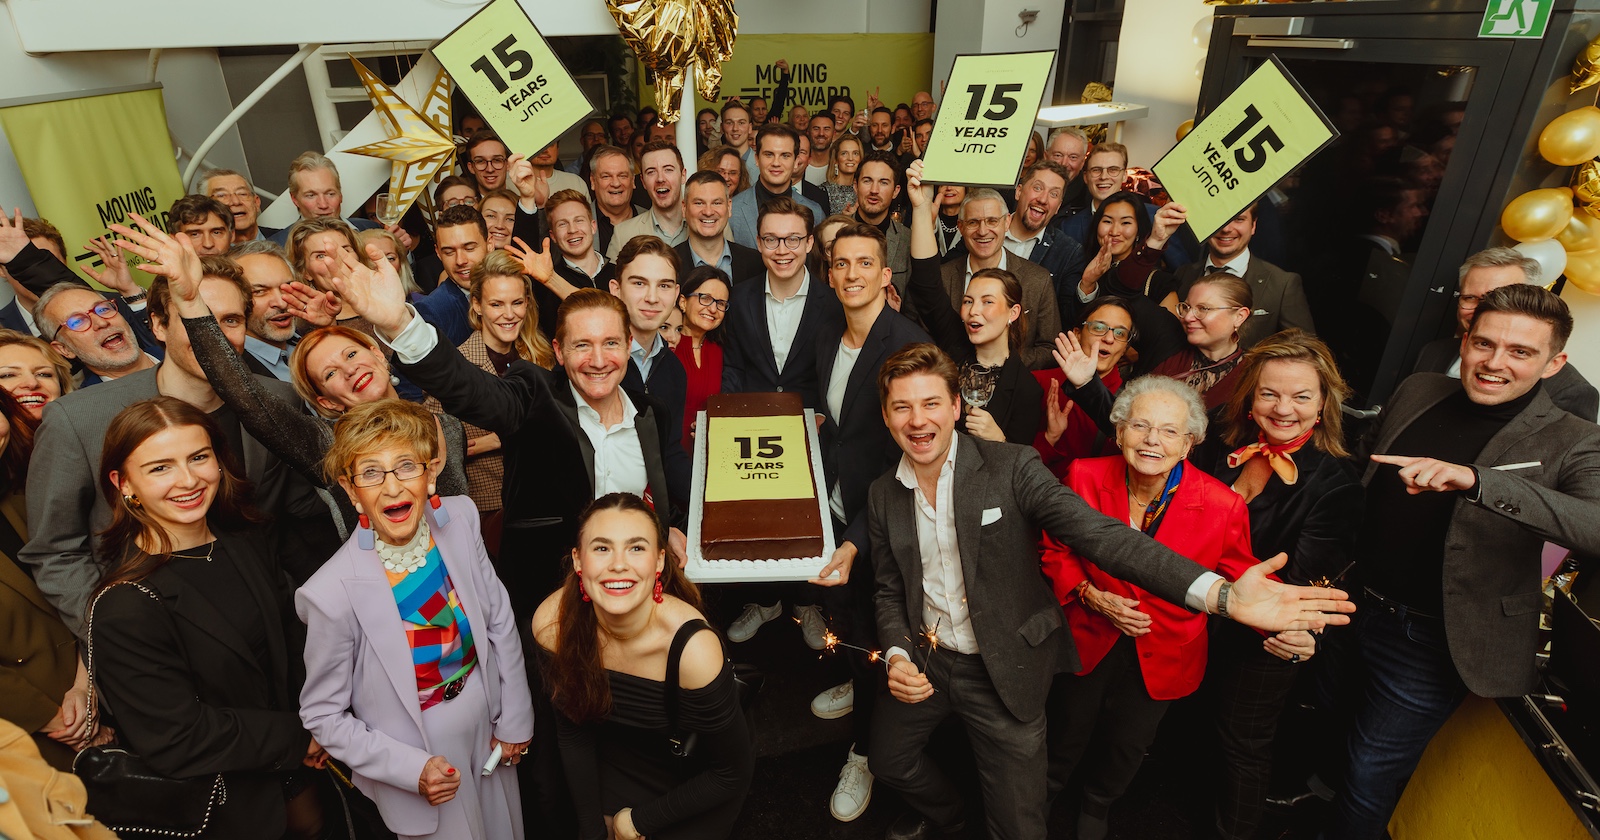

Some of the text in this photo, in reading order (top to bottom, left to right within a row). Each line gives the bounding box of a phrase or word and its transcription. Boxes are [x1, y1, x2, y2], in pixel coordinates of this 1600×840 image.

[470, 33, 534, 95] 15
[500, 74, 548, 112] YEARS
[964, 83, 1023, 121] 15
[954, 126, 1009, 138] YEARS
[1220, 103, 1285, 174] 15
[1202, 141, 1240, 191] YEARS
[96, 186, 157, 229] MOVING
[733, 435, 784, 459] 15
[734, 461, 785, 470] YEARS
